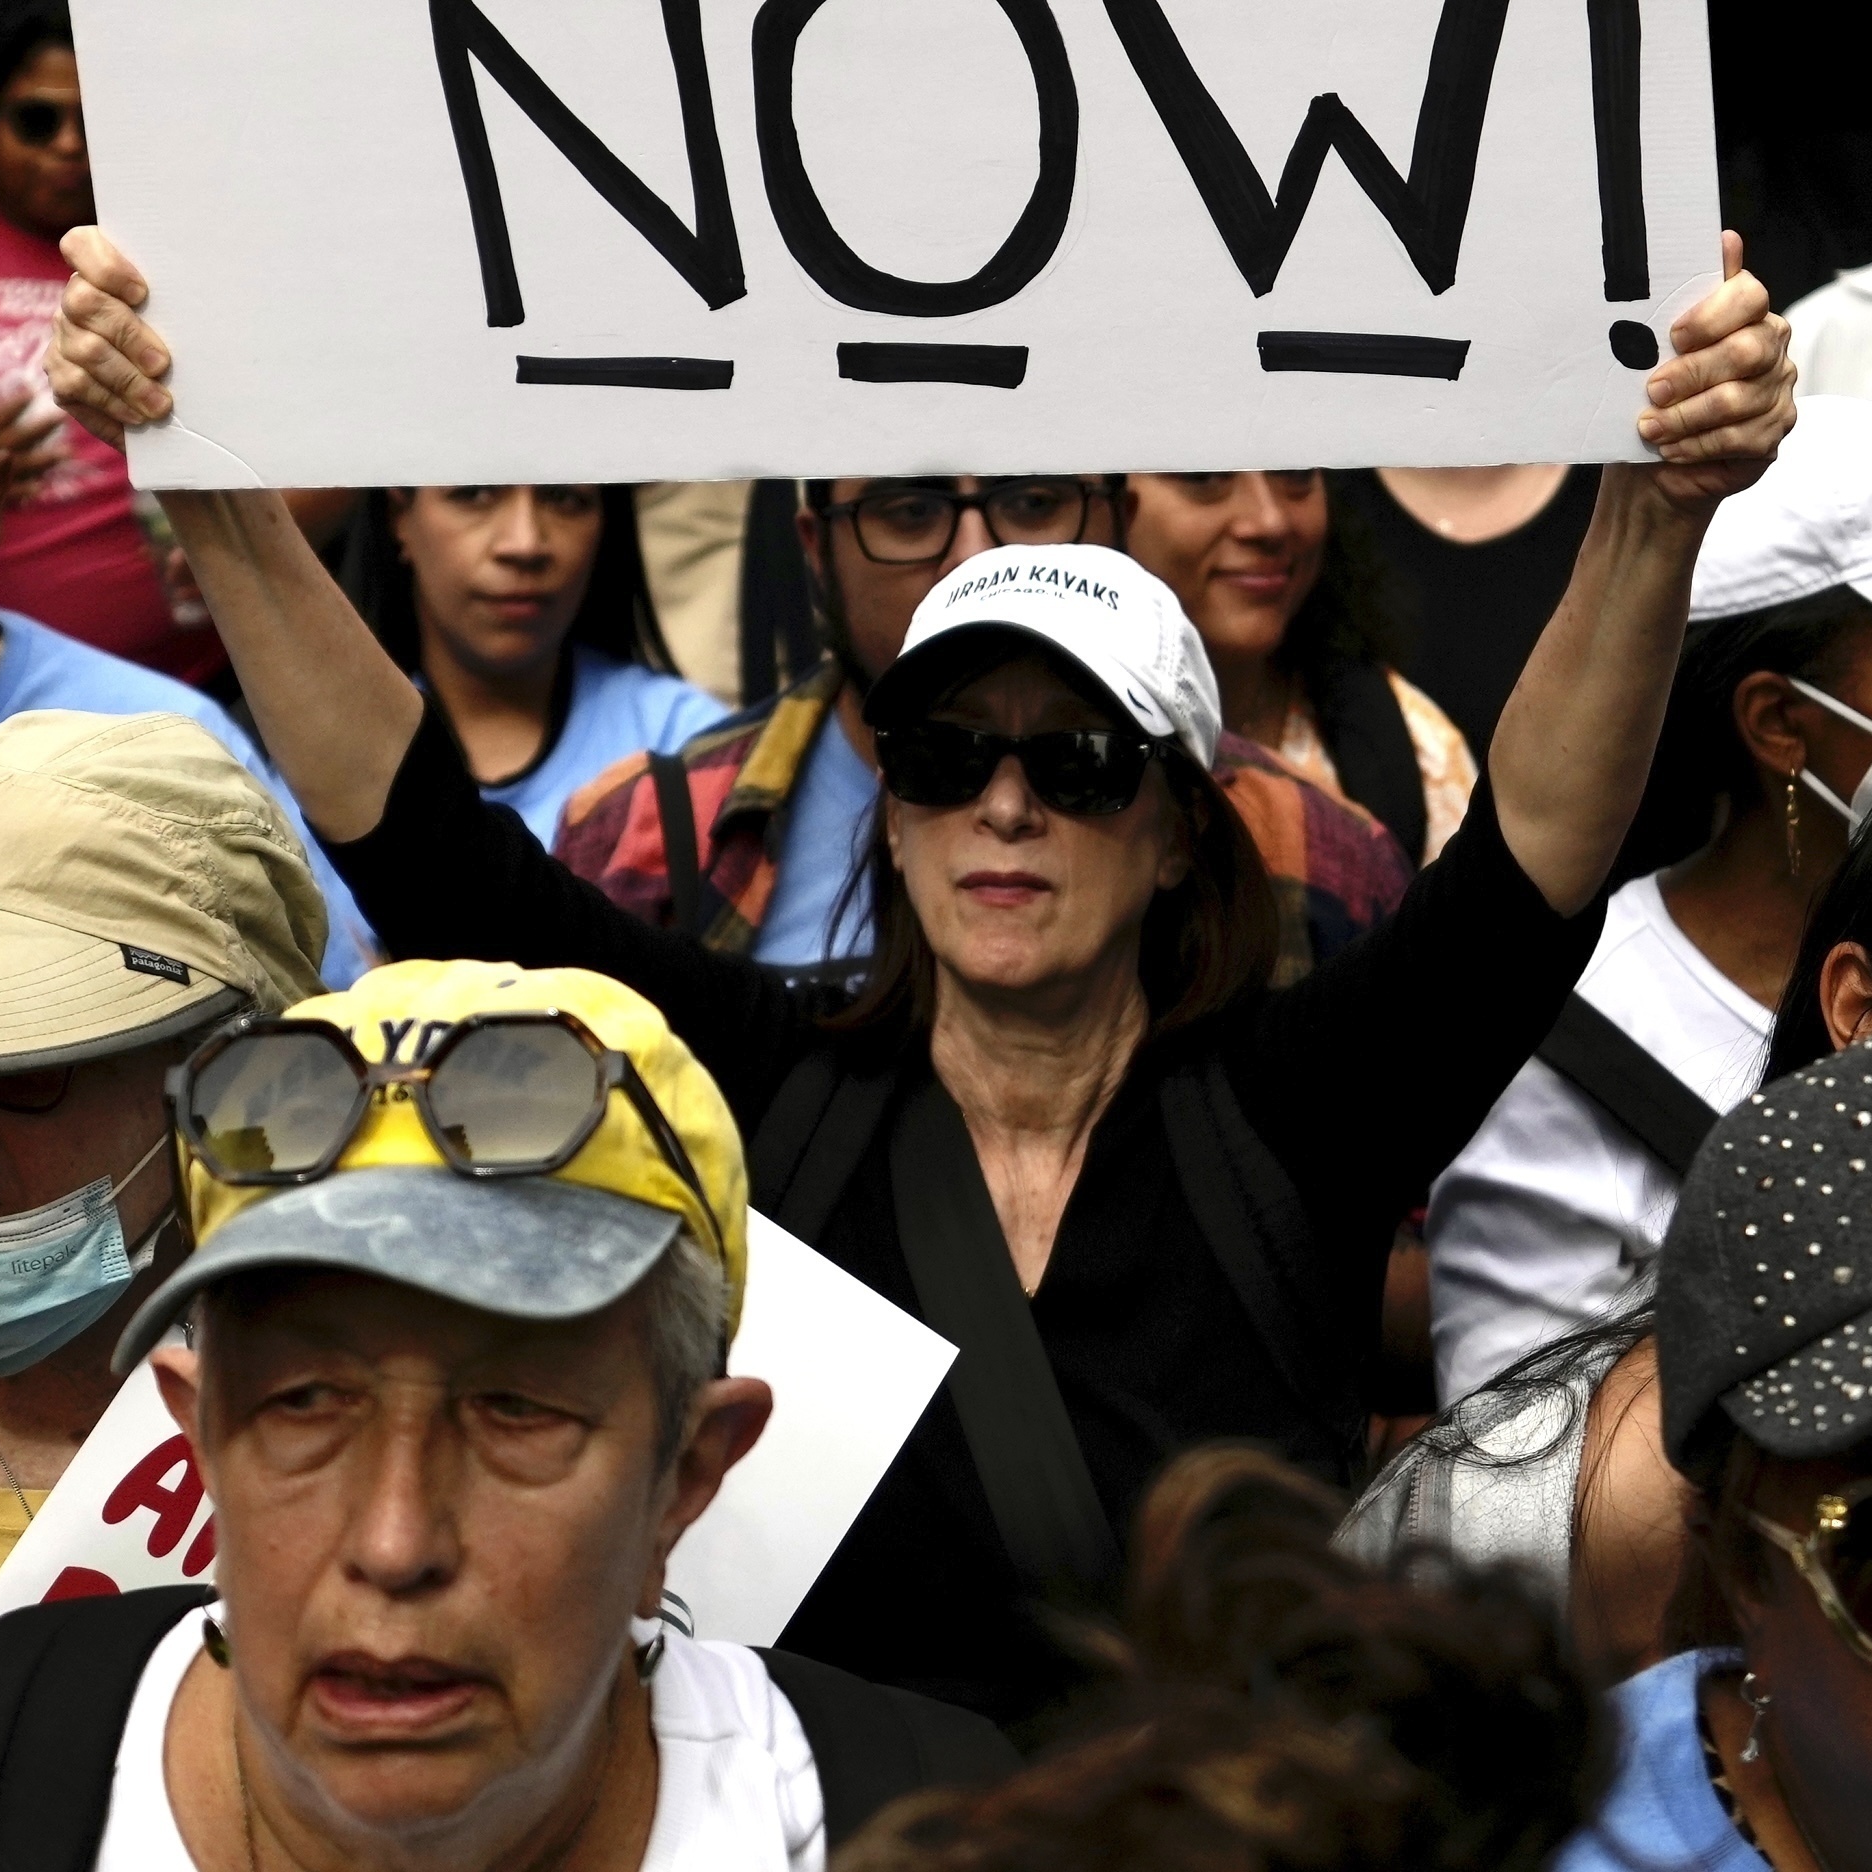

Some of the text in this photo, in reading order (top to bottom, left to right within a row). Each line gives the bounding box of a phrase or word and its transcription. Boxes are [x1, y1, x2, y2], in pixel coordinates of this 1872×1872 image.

[946, 565, 1119, 610] URBAN KAYAKS
[131, 956, 182, 976] patagonia
[11, 1244, 77, 1276] litepak
